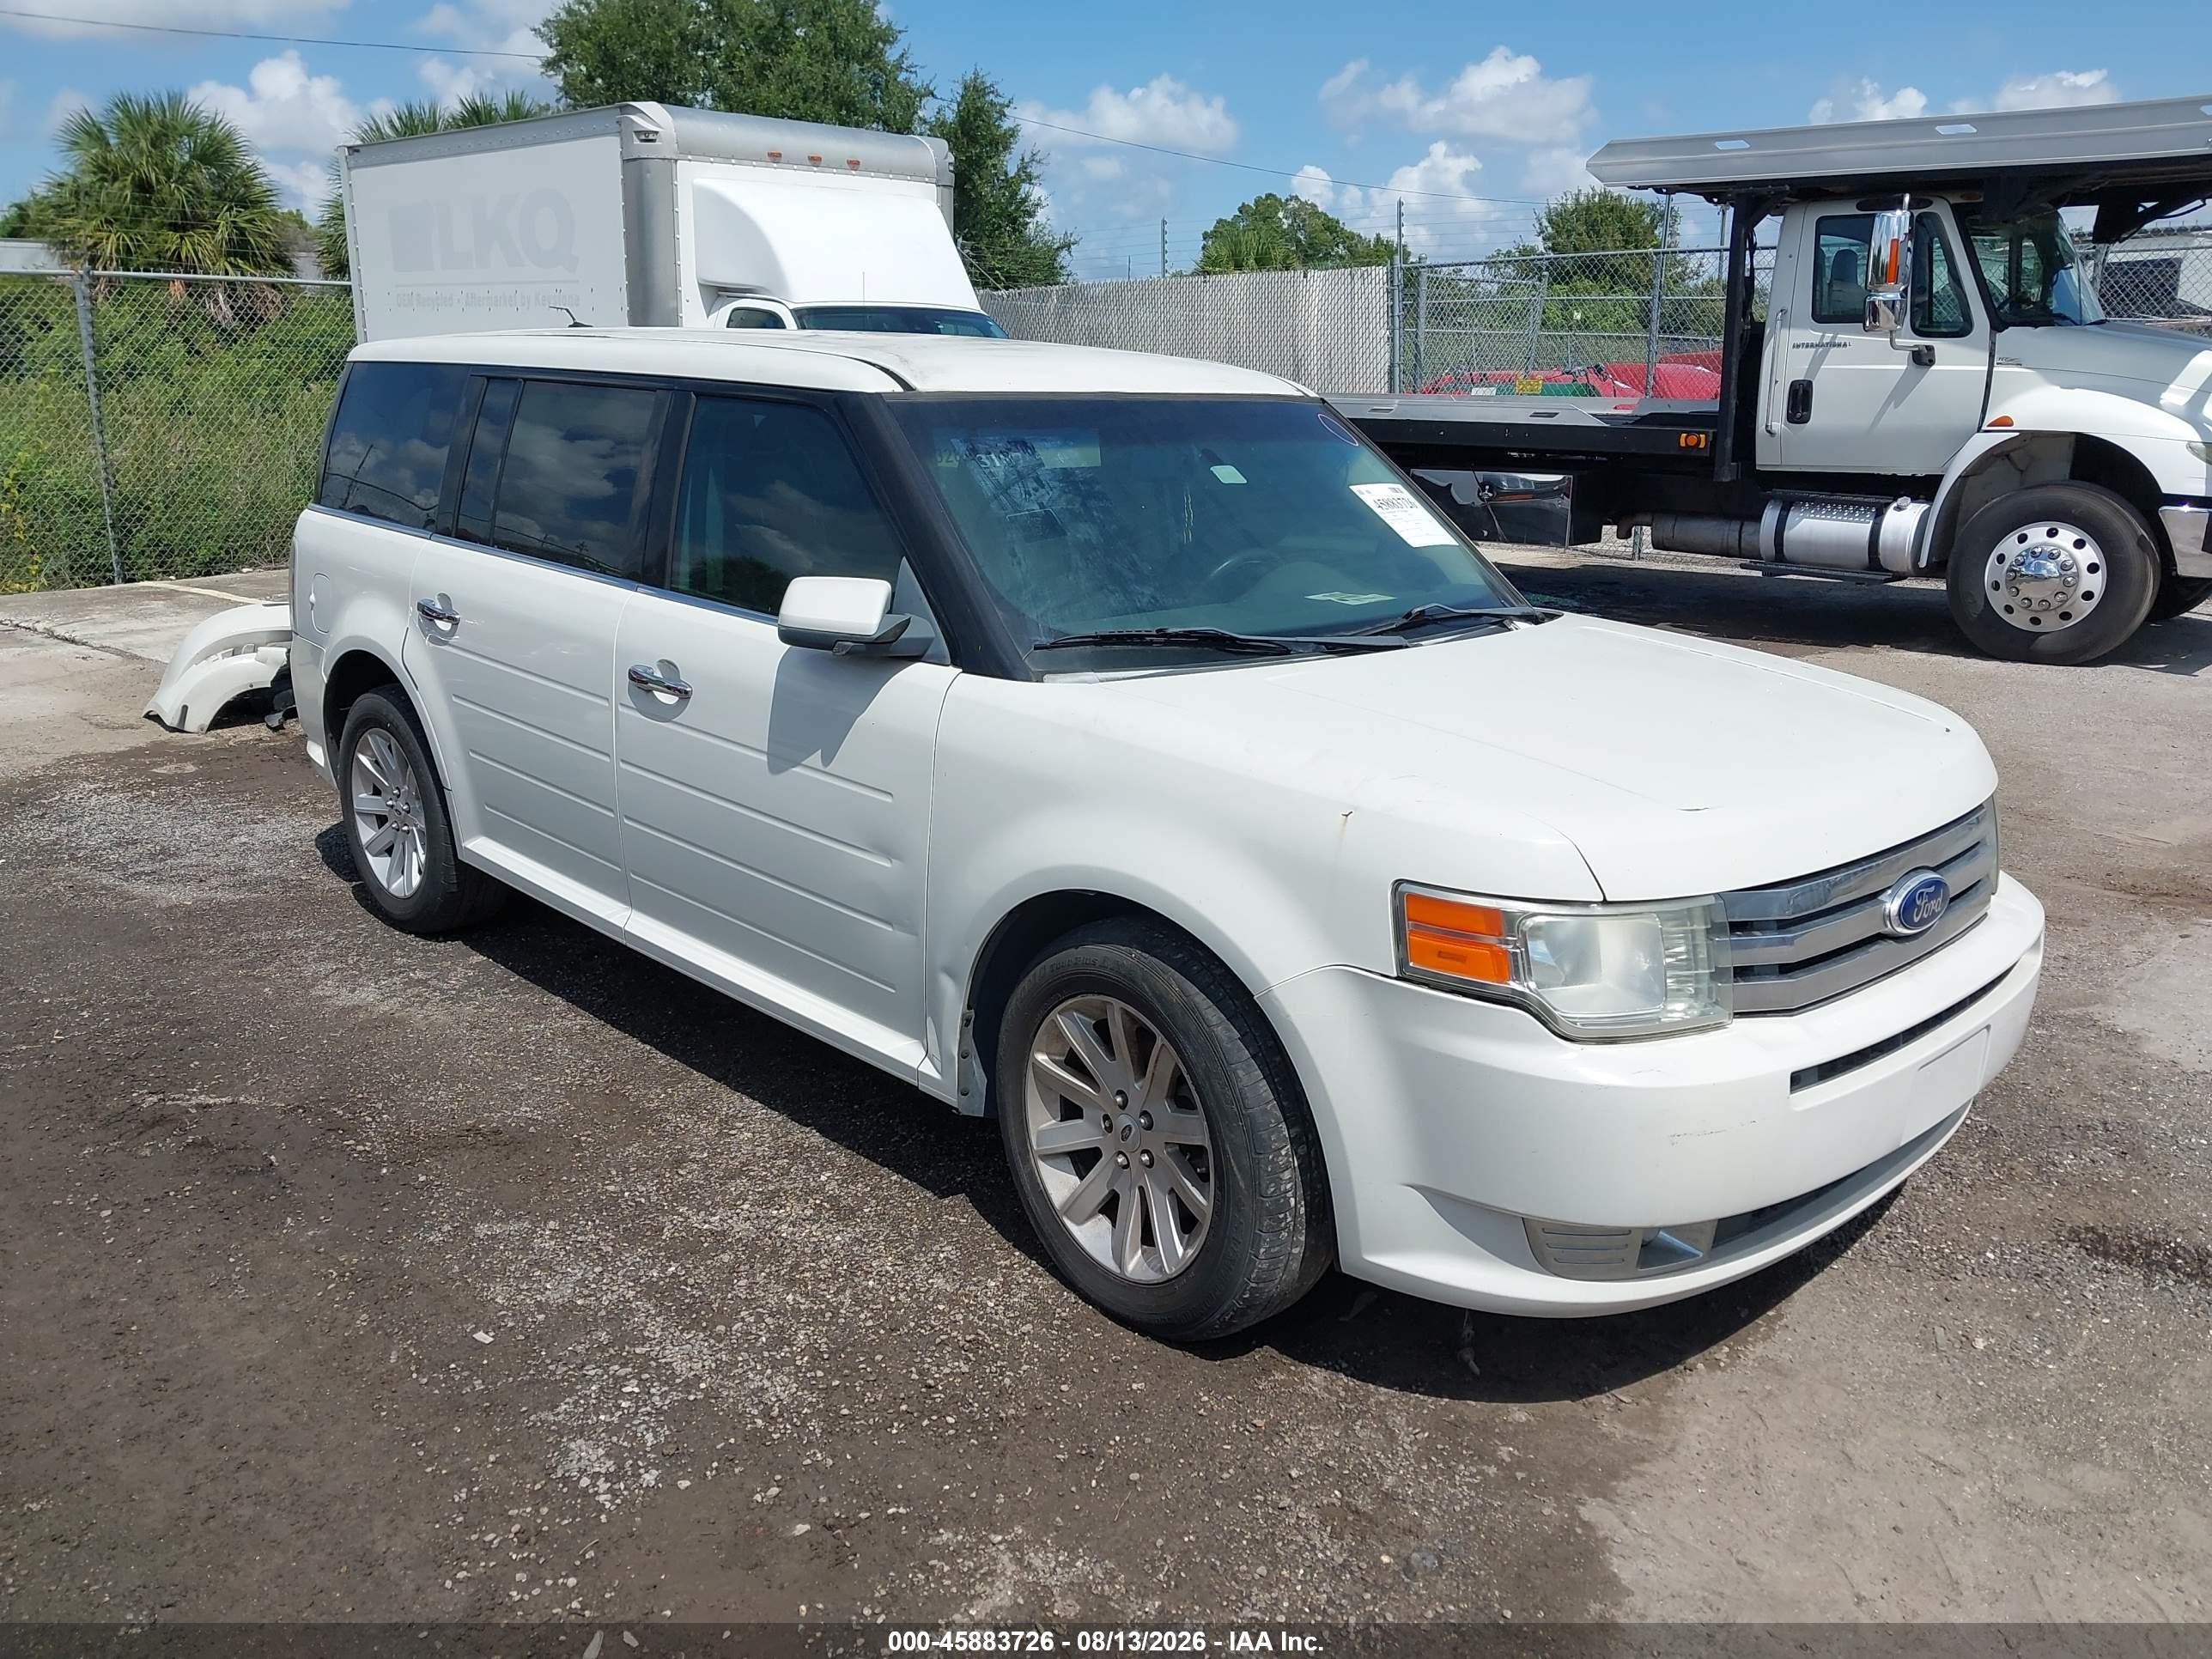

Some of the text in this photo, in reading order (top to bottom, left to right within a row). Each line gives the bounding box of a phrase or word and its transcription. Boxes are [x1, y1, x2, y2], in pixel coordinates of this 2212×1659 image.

[435, 188, 580, 274] LKQ
[465, 292, 518, 307] Aftermarket
[520, 292, 532, 310] by
[1913, 885, 1943, 923] Ford
